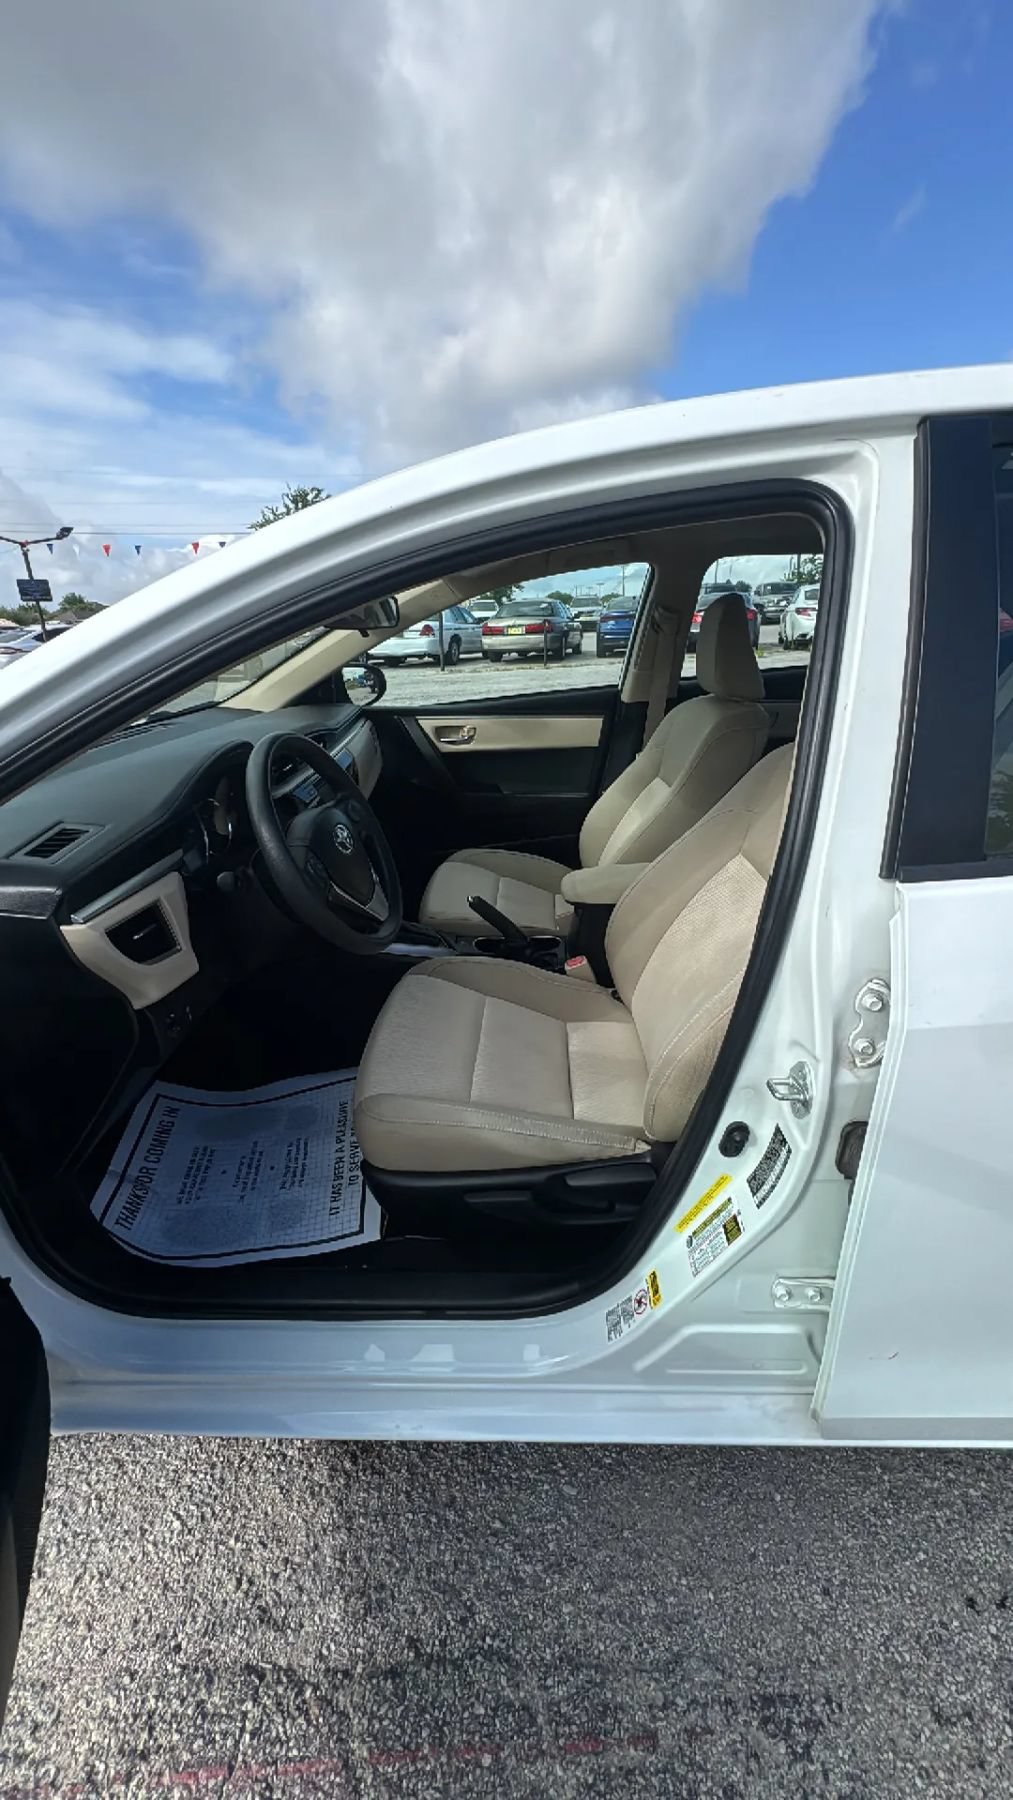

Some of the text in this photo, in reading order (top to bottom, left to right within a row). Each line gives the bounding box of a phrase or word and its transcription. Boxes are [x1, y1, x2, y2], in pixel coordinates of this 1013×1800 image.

[336, 1099, 349, 1145] PLEASURE
[114, 1182, 149, 1231] THANKS
[143, 1119, 176, 1164] COMING
[161, 1106, 181, 1118] IN
[333, 1155, 345, 1182] BEEN
[348, 1174, 359, 1186] TO
[330, 1183, 343, 1203] HAS
[329, 1207, 340, 1216] IT
